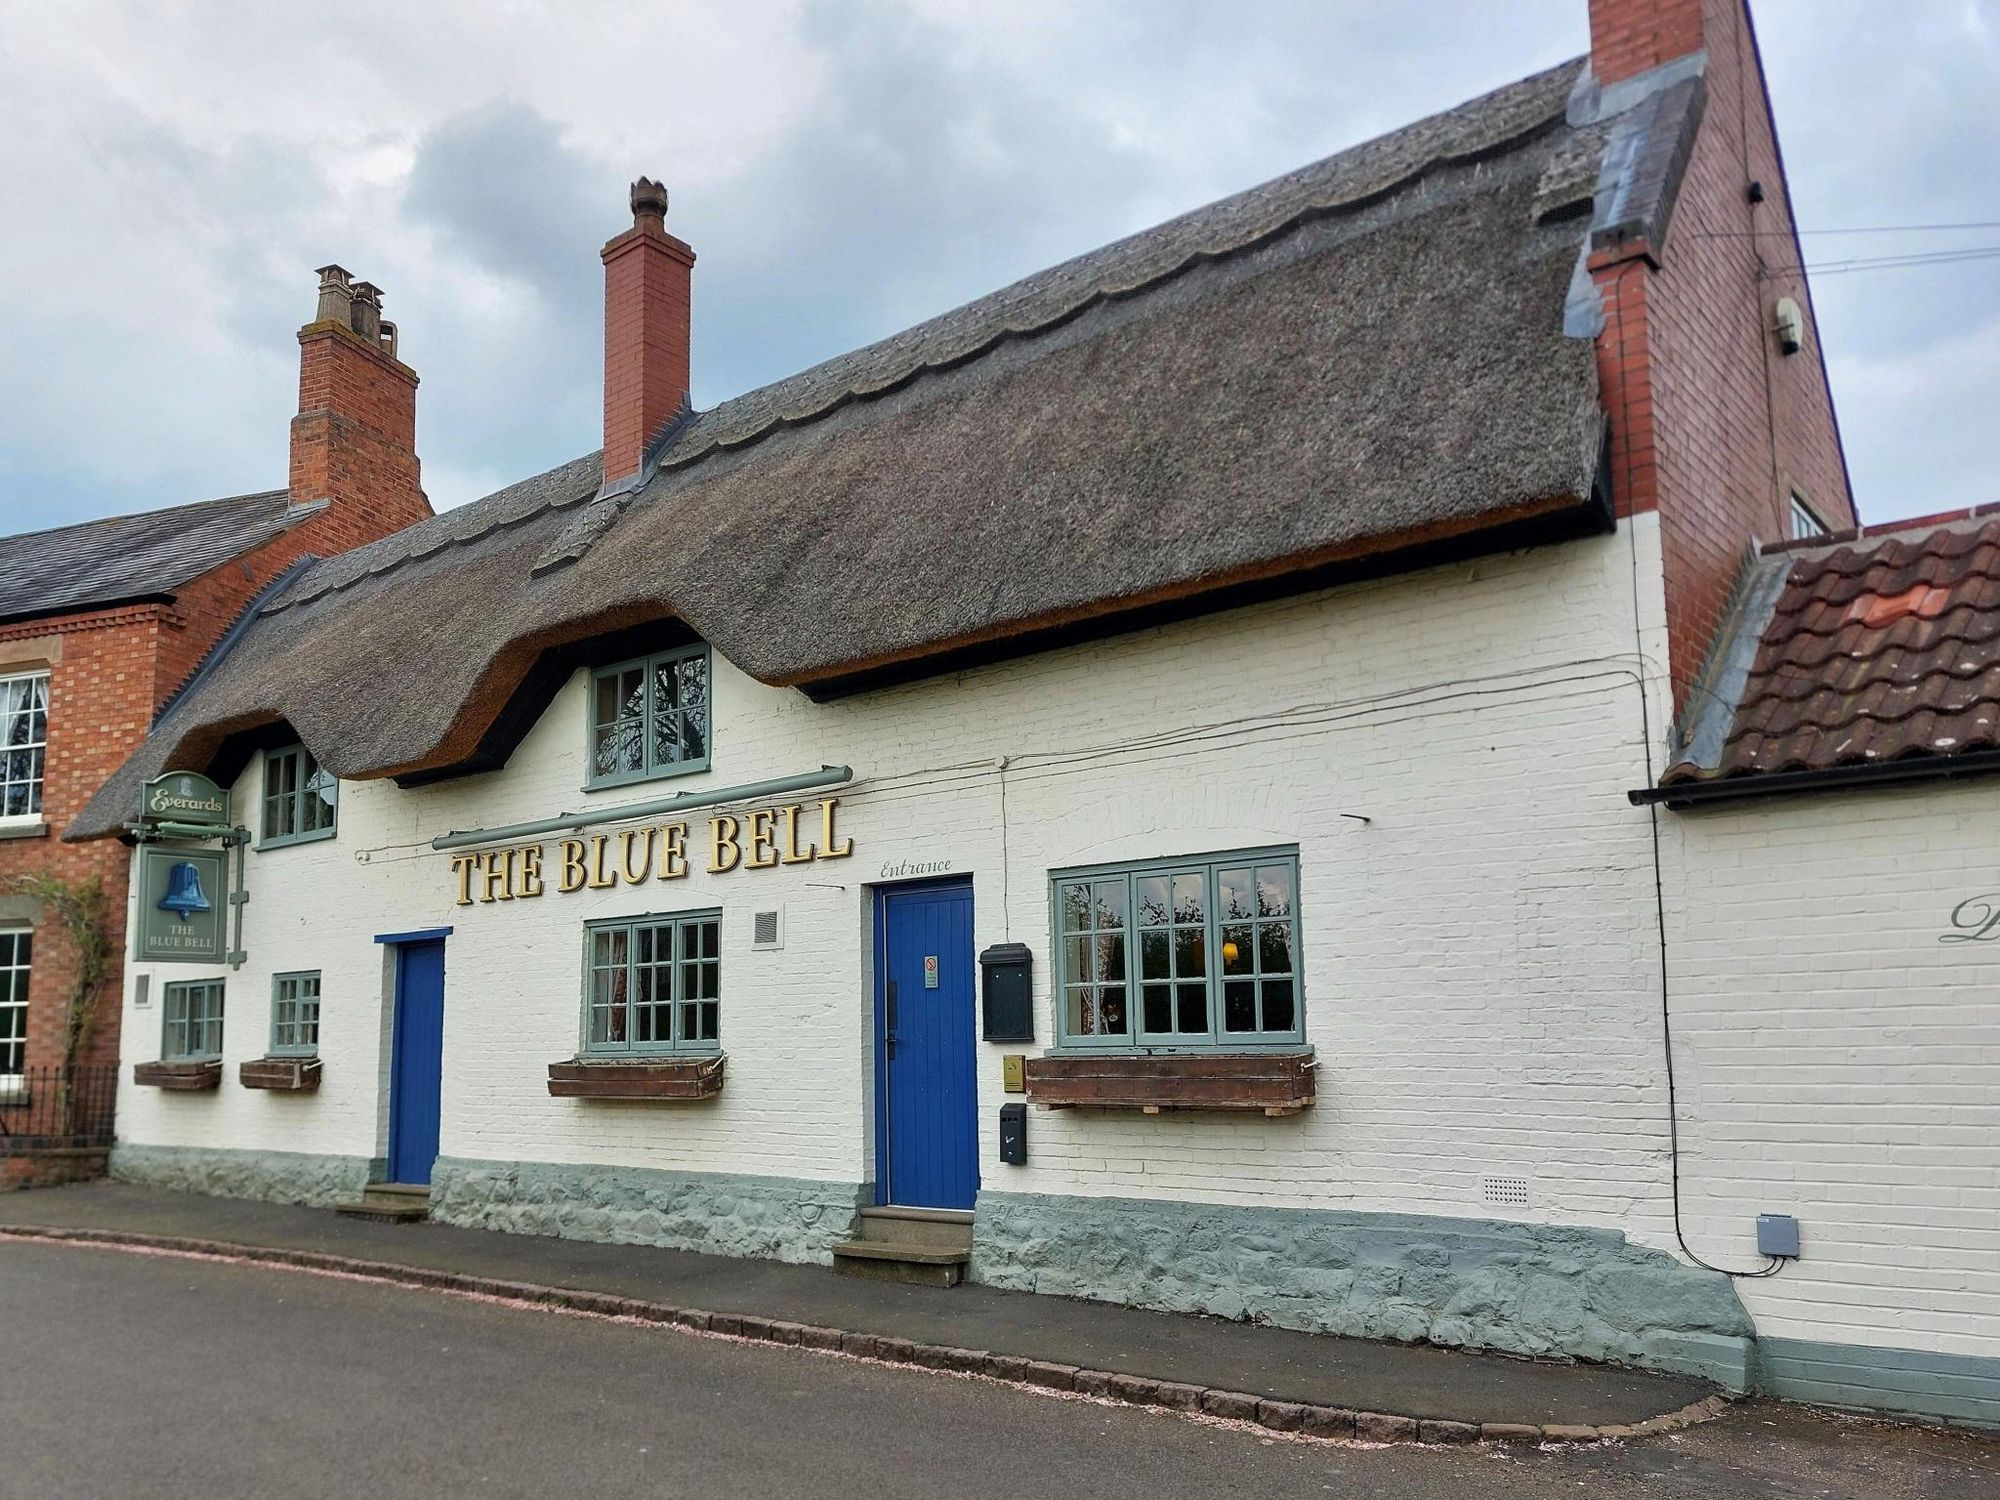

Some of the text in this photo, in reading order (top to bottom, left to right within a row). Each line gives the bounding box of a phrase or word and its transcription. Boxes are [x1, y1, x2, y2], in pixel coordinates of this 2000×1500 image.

[150, 788, 223, 812] Everards
[451, 798, 853, 906] THE BLUE BELL
[880, 858, 953, 878] Entrance
[169, 924, 195, 936] THE
[149, 936, 213, 948] BLUE BELL
